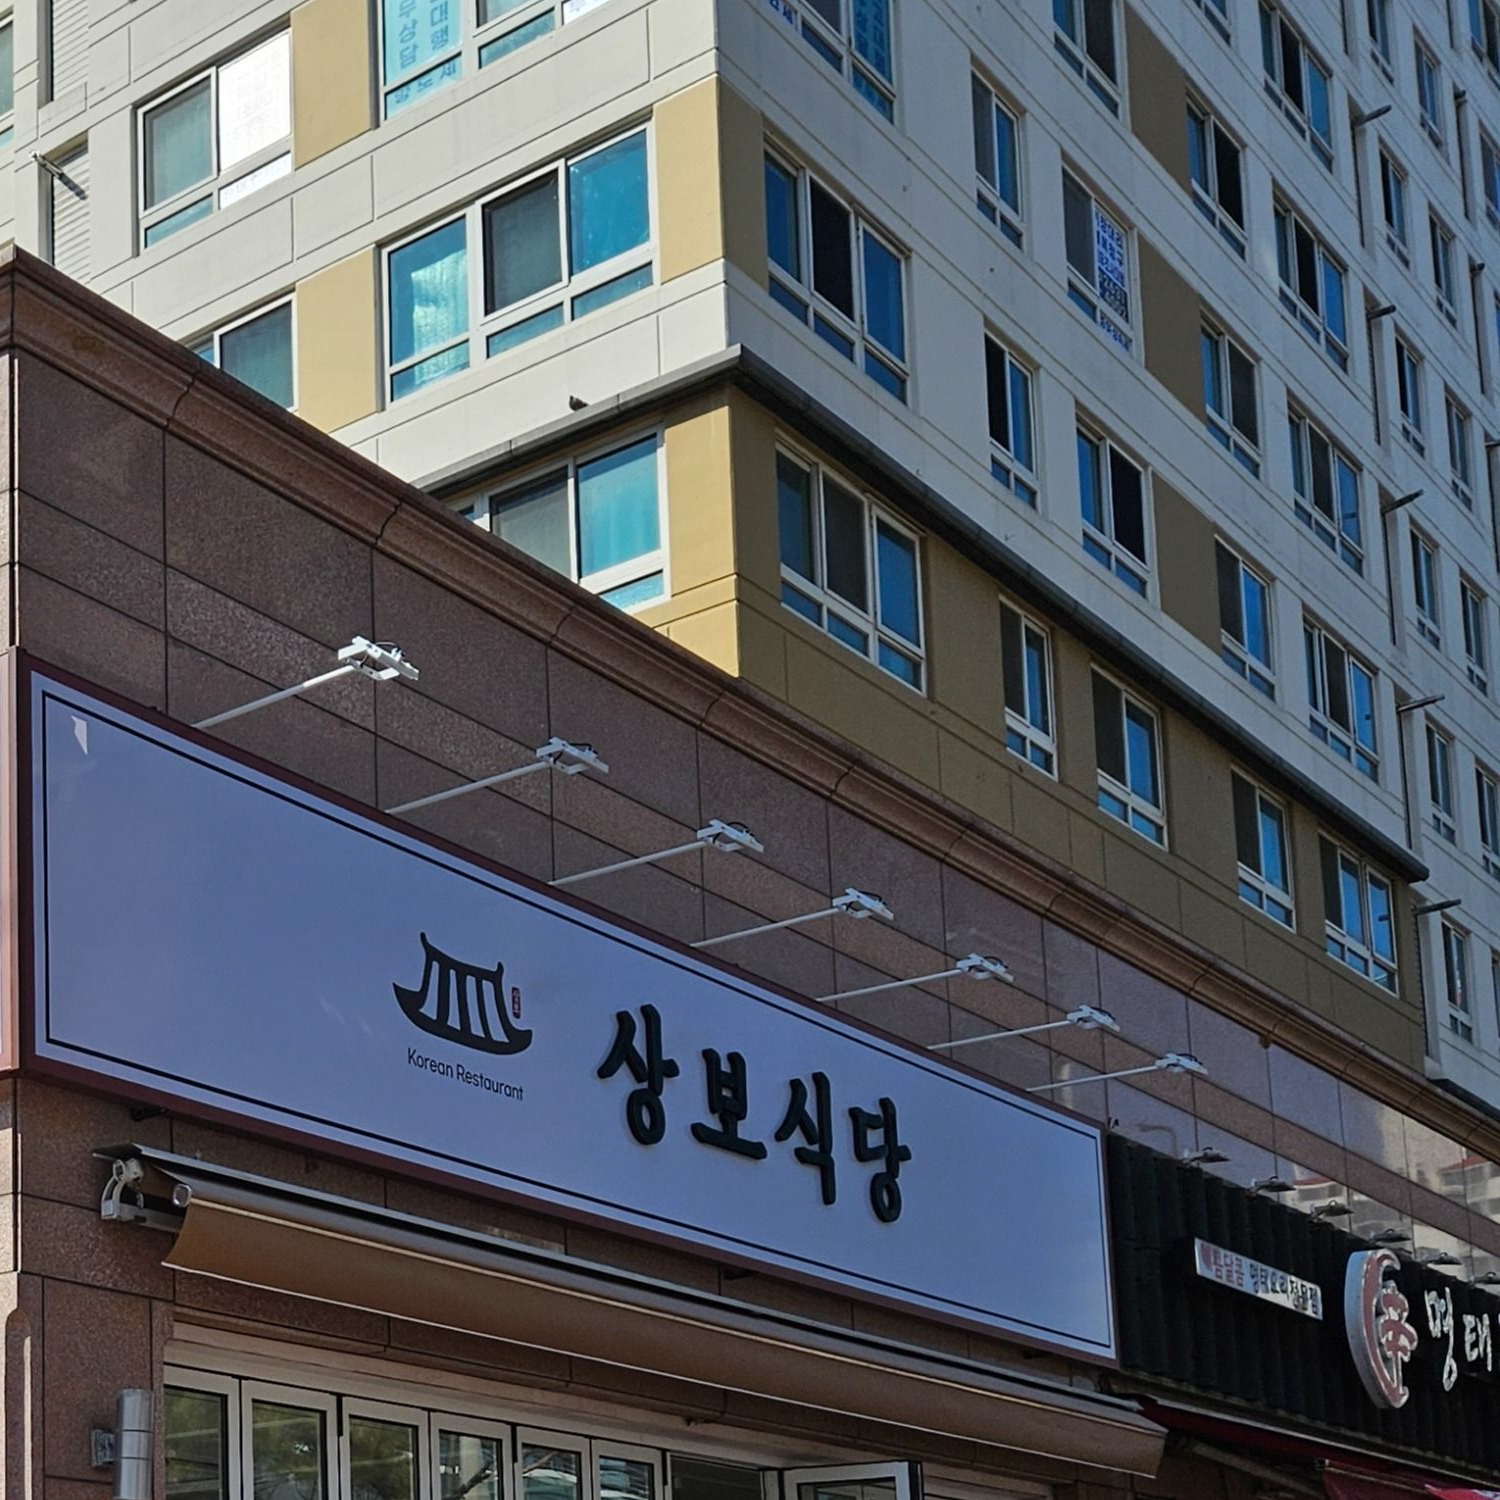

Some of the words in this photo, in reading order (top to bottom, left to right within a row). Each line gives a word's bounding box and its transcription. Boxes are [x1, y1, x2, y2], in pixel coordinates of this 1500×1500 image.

[407, 1047, 454, 1077] Korean
[457, 1063, 524, 1101] Restaurant
[597, 1004, 912, 1224] 상보식당
[1424, 1286, 1500, 1391] 명태
